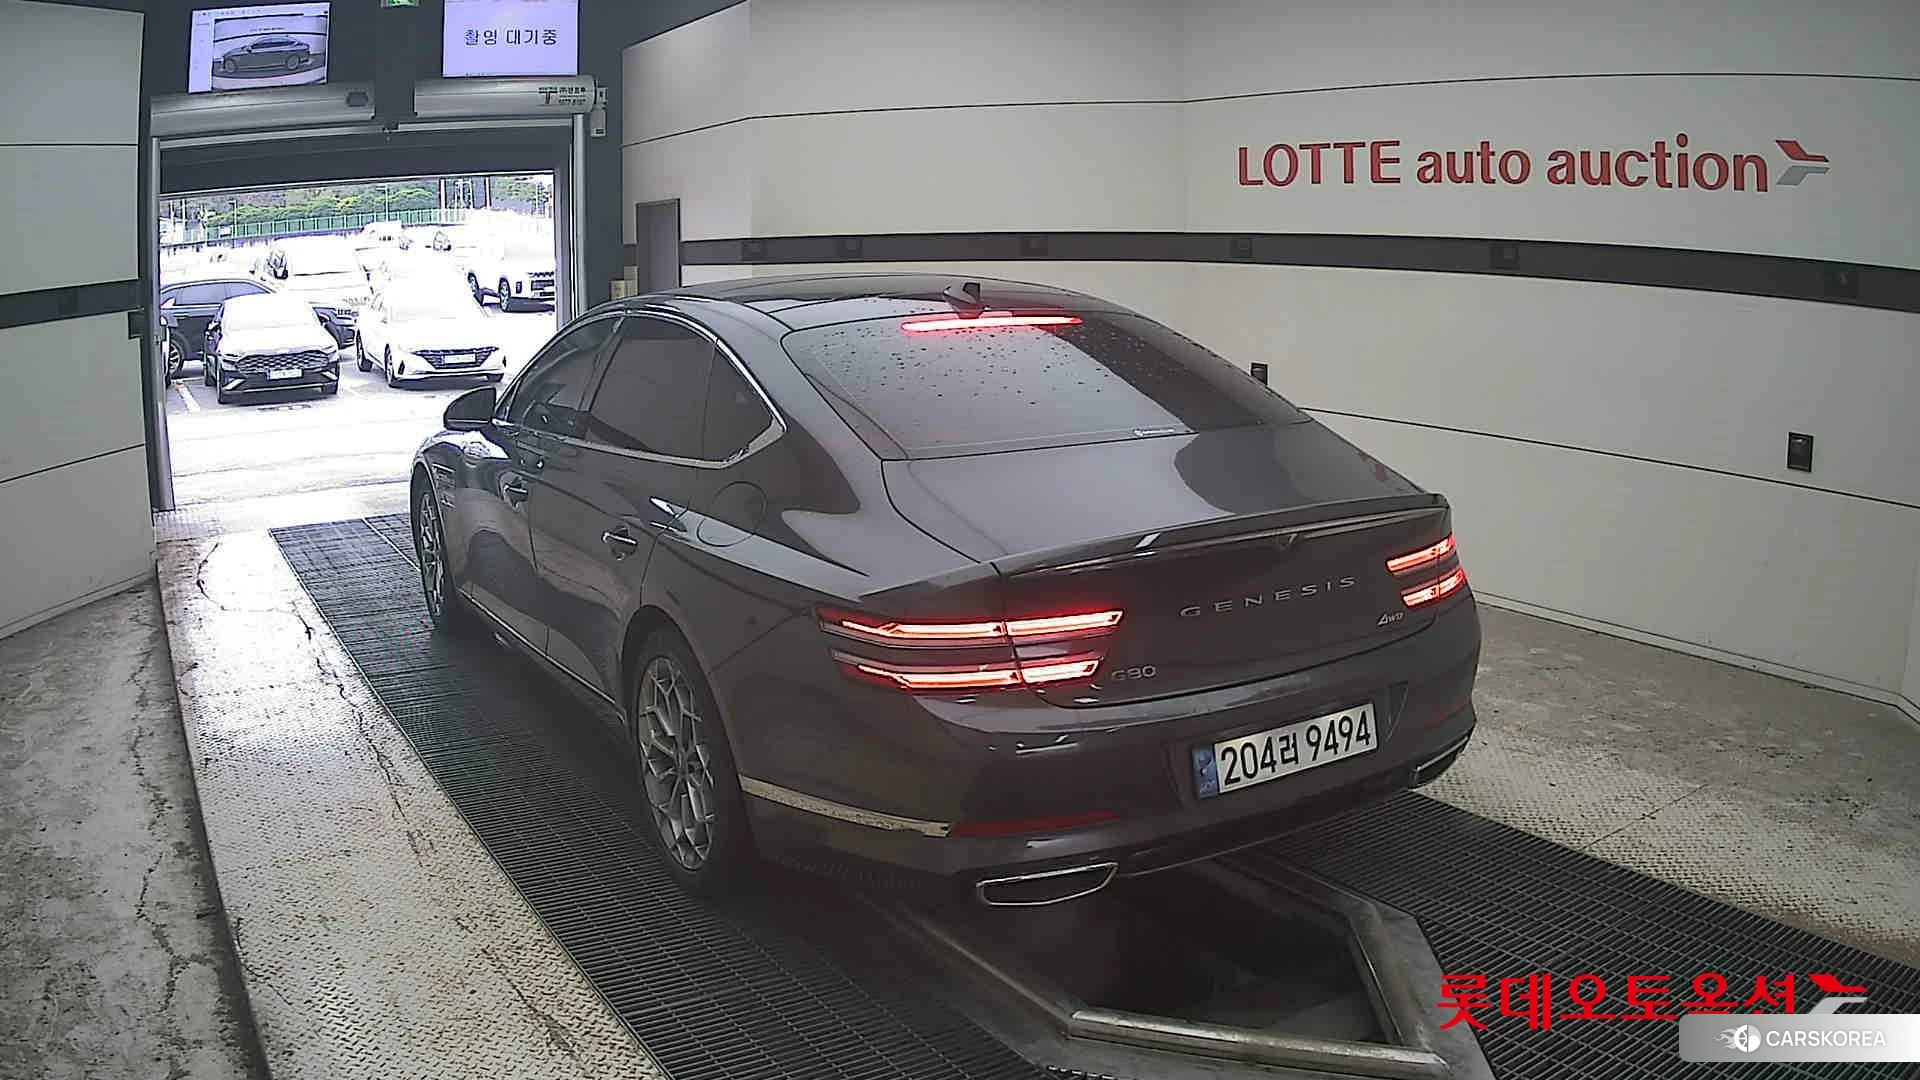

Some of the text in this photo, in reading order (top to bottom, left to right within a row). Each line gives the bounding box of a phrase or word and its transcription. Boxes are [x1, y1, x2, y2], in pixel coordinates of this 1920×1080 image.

[505, 29, 557, 46] 대기중
[1238, 132, 1769, 193] LOTTE auto auction
[1179, 576, 1356, 617] GENESIS
[1221, 710, 1372, 786] 204러 9494
